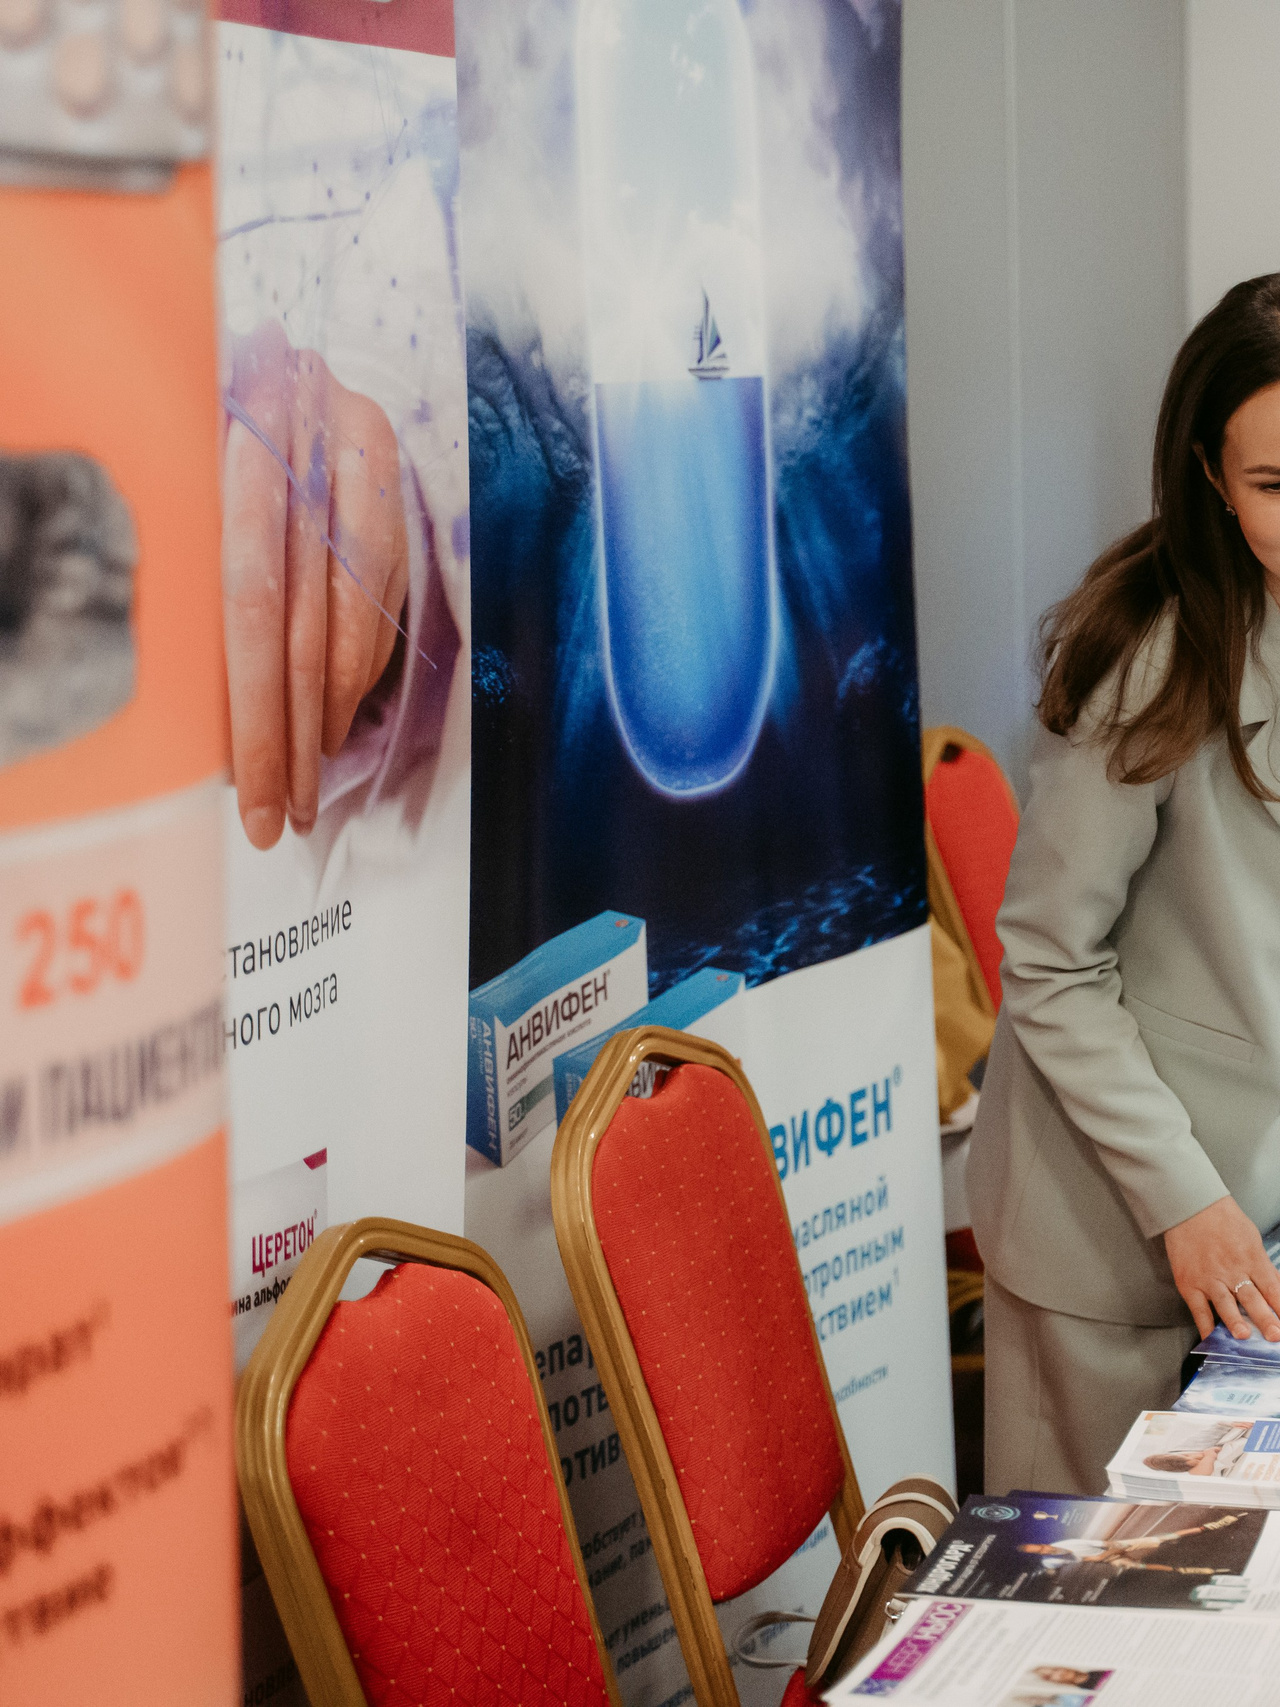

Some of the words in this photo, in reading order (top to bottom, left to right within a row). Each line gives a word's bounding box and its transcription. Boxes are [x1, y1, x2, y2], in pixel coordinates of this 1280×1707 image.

[16, 890, 145, 1010] 250
[228, 900, 352, 979] тановление
[289, 973, 338, 1027] мозга
[252, 1216, 315, 1278] ЦЕРЕТОН
